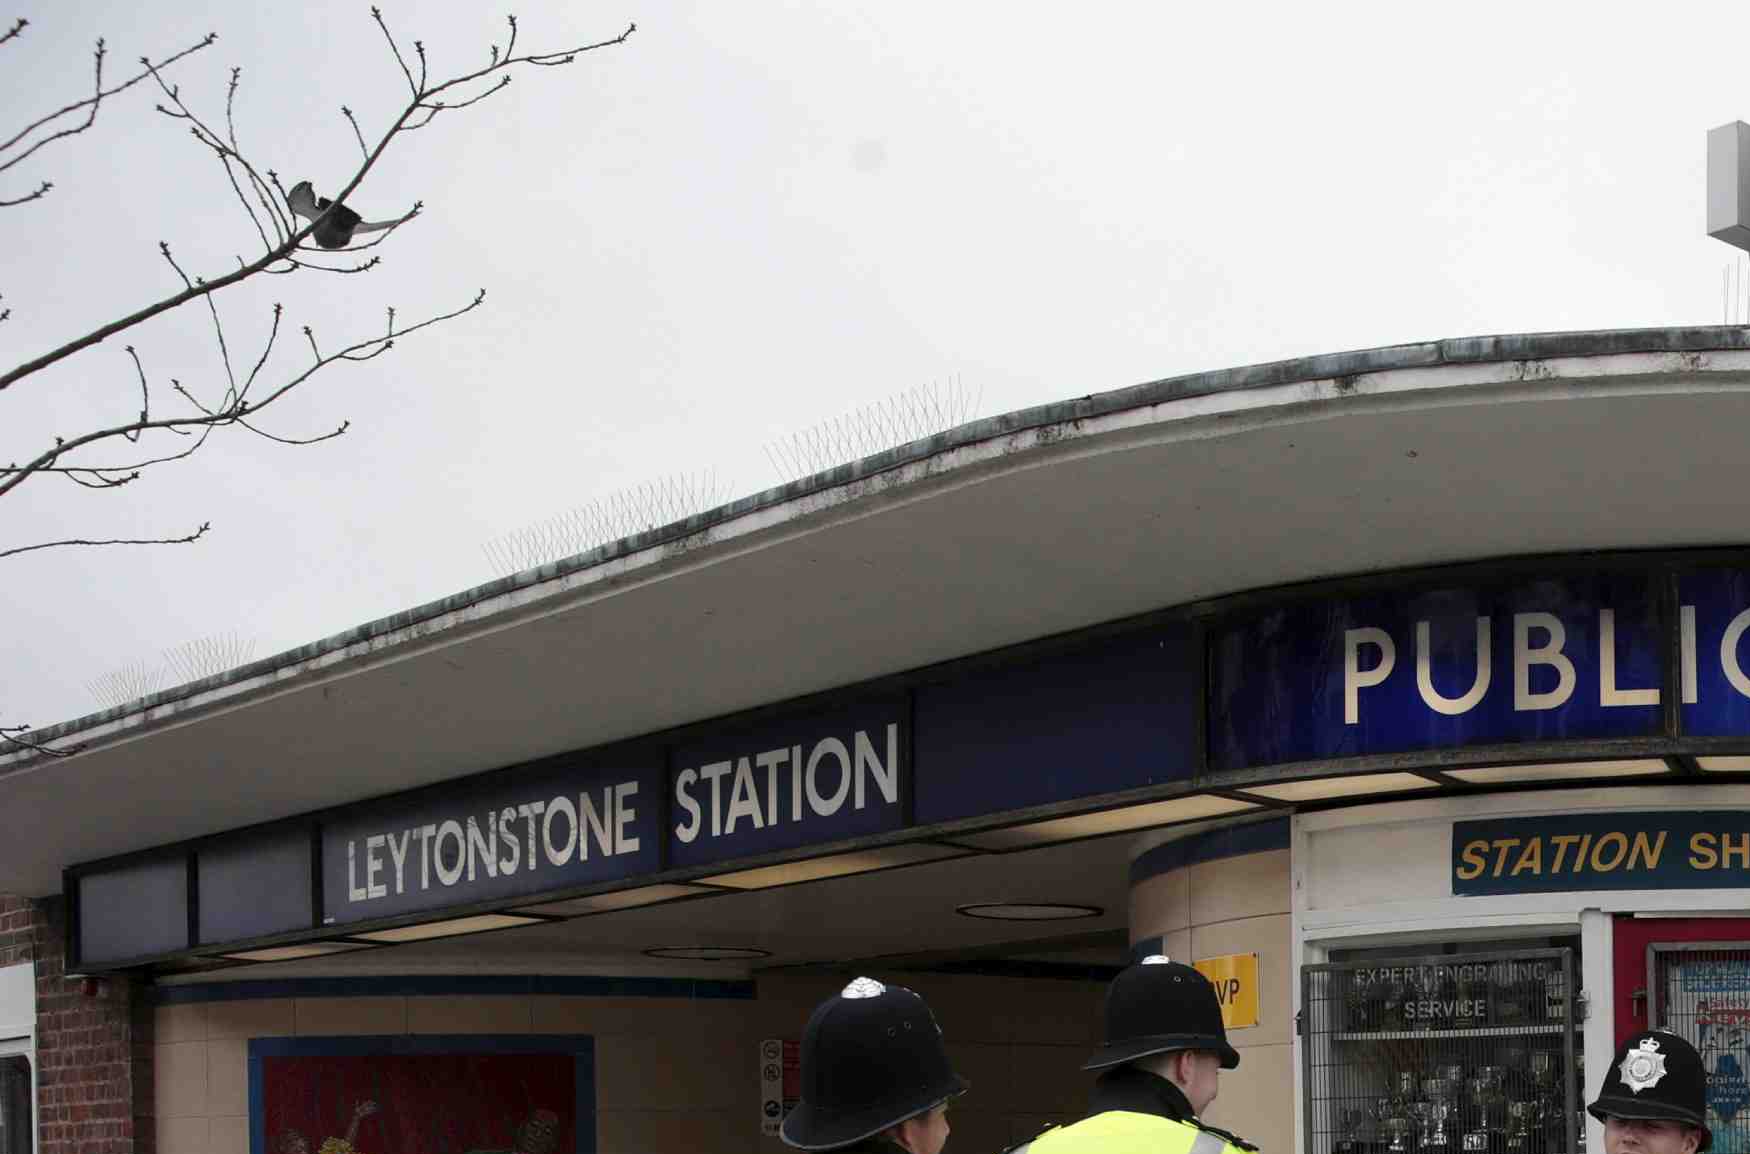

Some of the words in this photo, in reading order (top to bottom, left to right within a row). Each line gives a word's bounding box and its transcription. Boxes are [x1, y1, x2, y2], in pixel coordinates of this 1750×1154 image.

[347, 781, 640, 902] LEYTONSTONE
[675, 723, 898, 843] STATION
[1455, 830, 1667, 879] STATION
[1354, 965, 1427, 985] EXPERT
[1215, 978, 1240, 1005] VP
[1404, 999, 1486, 1019] SERVICE
